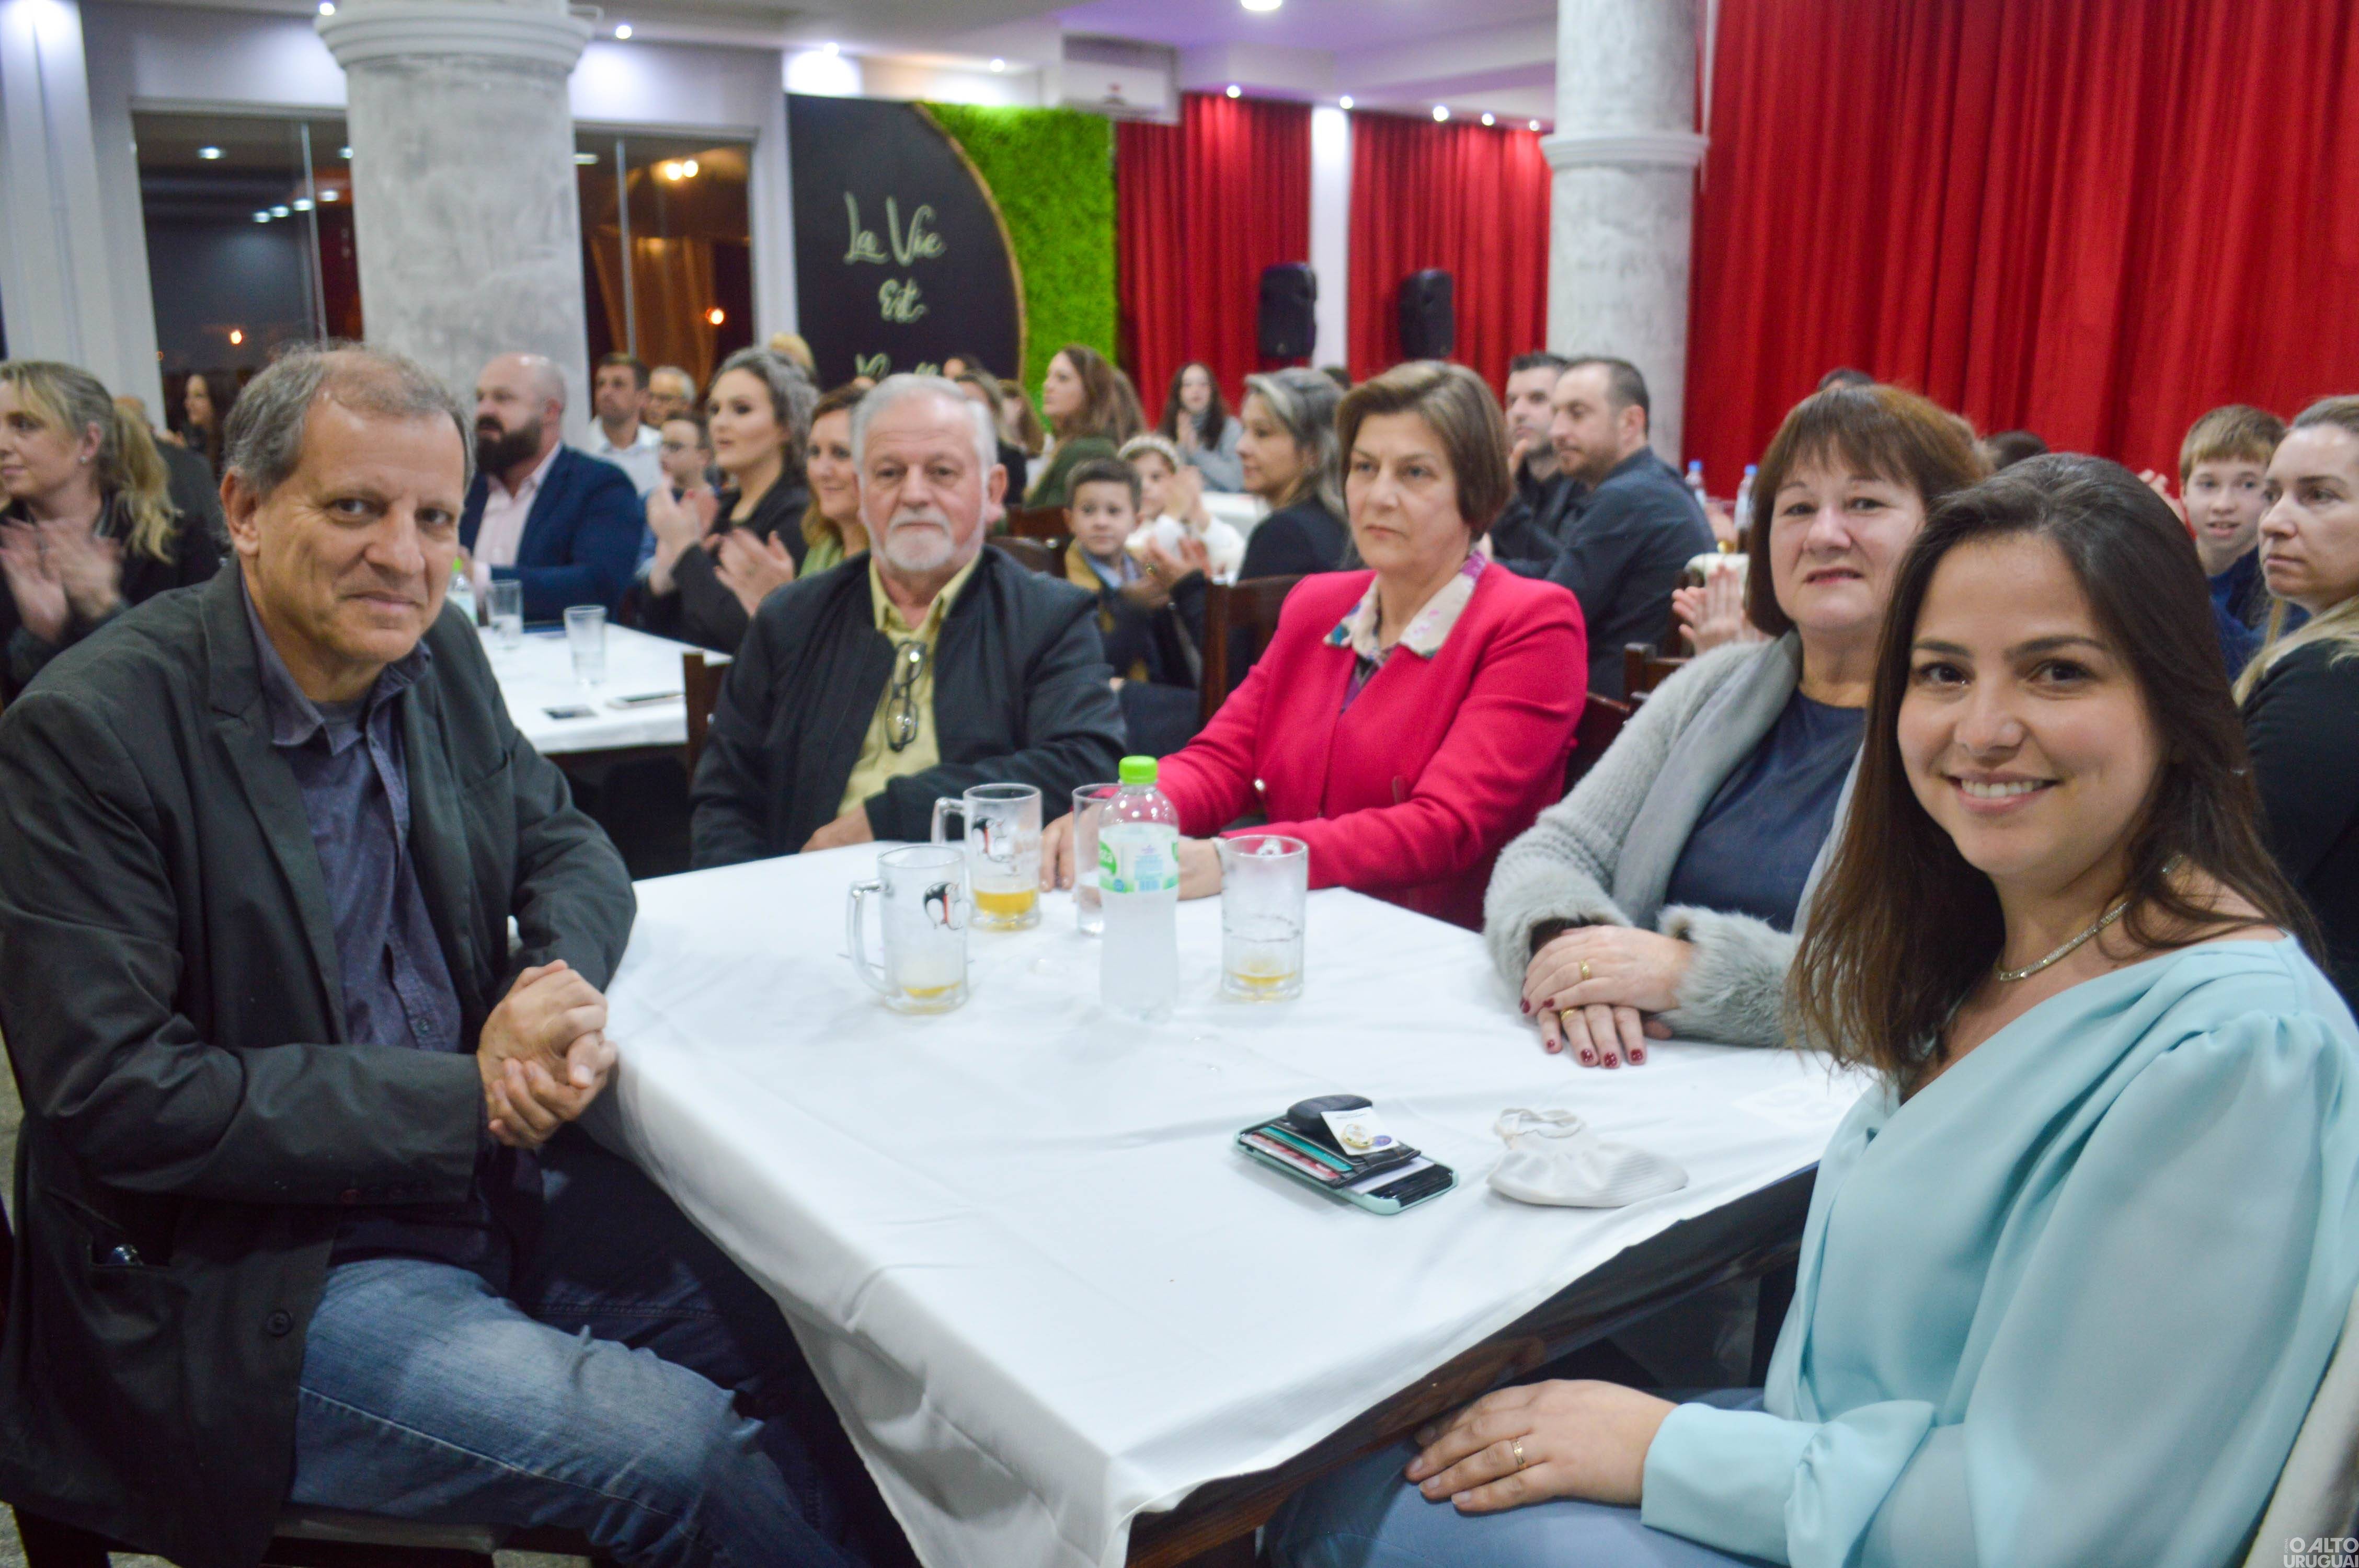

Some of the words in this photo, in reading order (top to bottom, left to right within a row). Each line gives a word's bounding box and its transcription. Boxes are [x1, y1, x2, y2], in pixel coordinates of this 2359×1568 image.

[843, 191, 890, 264] La
[886, 196, 947, 267] Vie
[878, 278, 929, 324] Est
